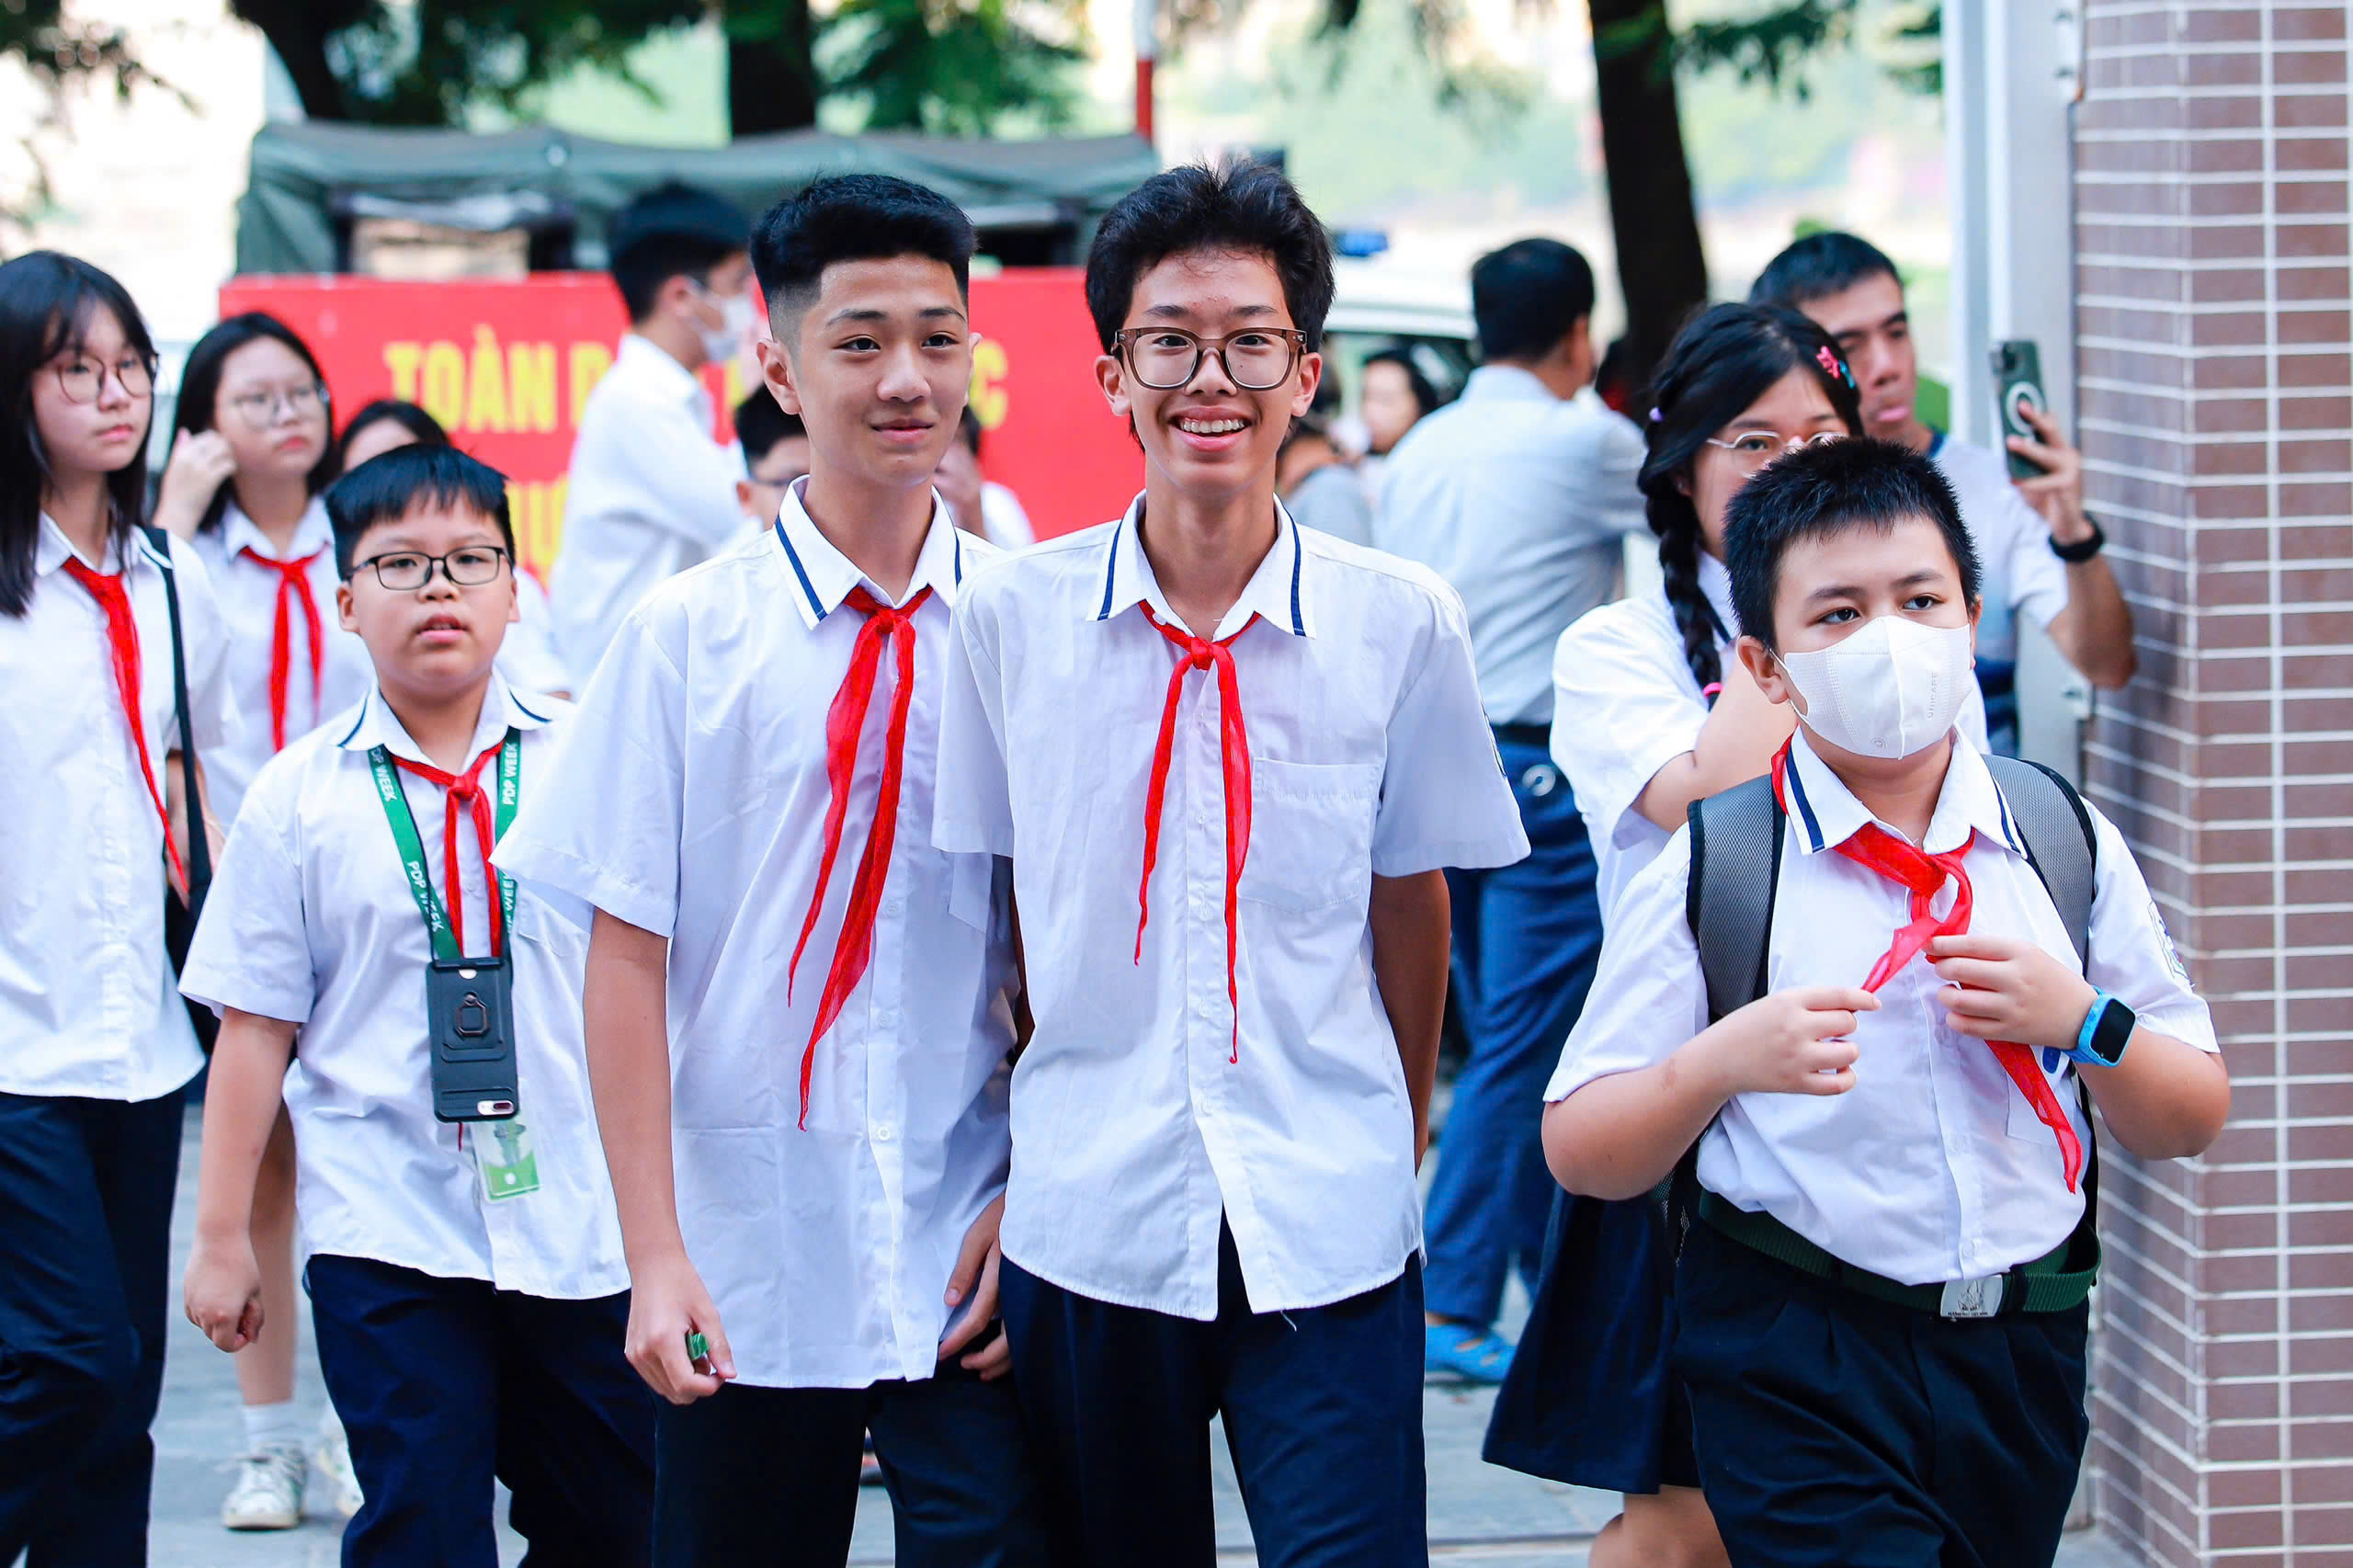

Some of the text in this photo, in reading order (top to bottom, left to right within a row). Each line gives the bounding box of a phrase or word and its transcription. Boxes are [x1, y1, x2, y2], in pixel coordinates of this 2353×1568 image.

[371, 747, 397, 801] DP WEEK
[503, 743, 517, 805] PDP WEEK
[407, 860, 426, 889] PDP
